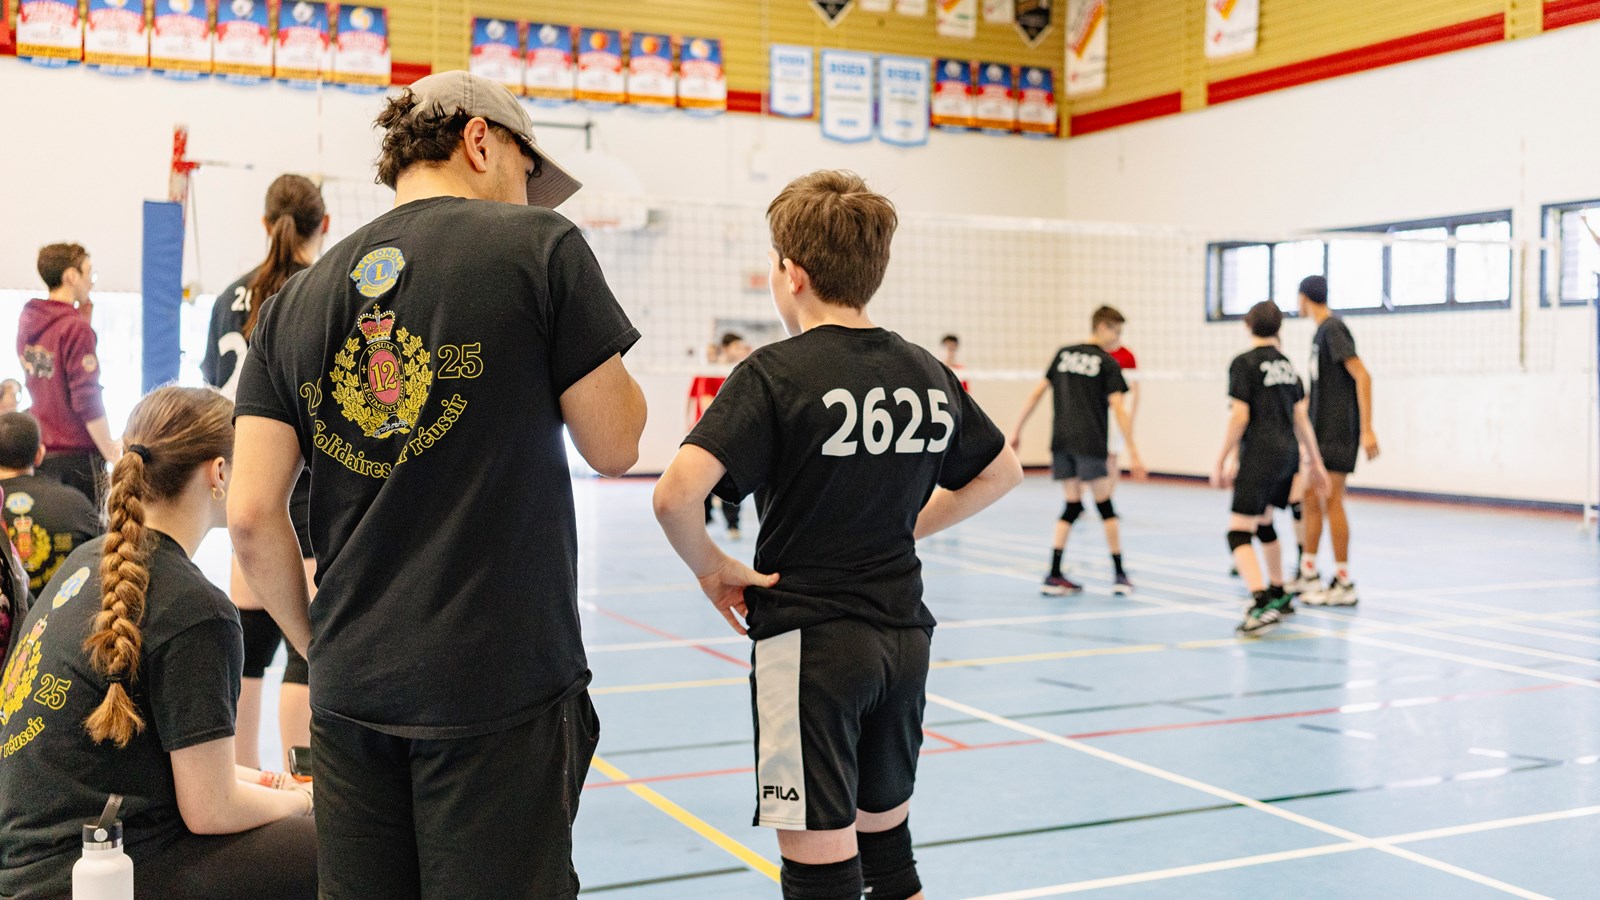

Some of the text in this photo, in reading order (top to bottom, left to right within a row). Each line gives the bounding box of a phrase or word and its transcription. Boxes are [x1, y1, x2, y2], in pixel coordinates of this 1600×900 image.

[366, 249, 398, 262] LIONS
[375, 263, 388, 281] L
[367, 342, 393, 356] ADSUM
[438, 342, 484, 379] 25
[409, 393, 467, 456] réussir
[821, 387, 955, 457] 2625
[33, 673, 72, 710] 25
[3, 716, 46, 758] réussir
[763, 785, 800, 801] FILA
